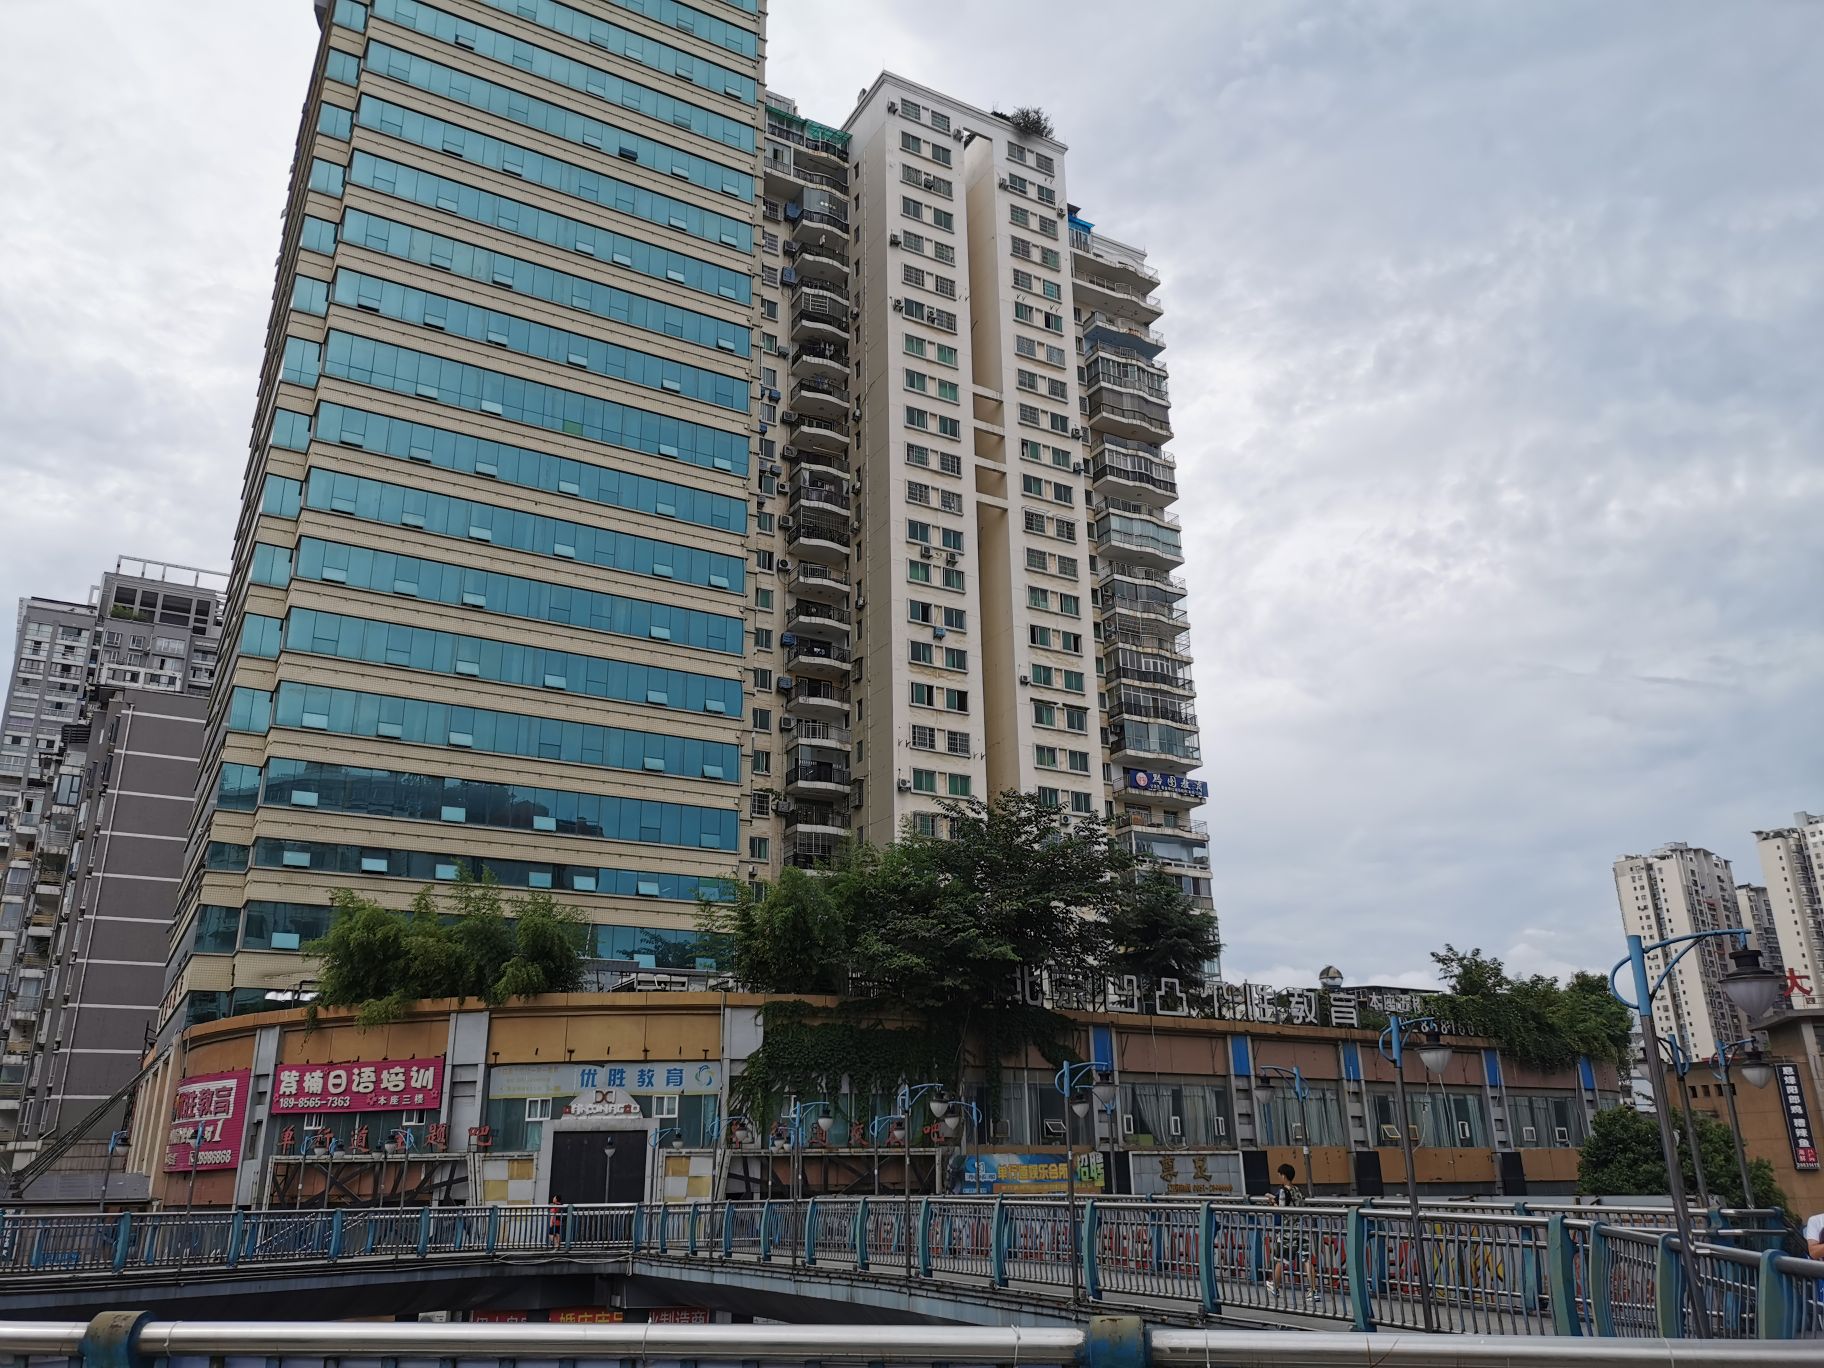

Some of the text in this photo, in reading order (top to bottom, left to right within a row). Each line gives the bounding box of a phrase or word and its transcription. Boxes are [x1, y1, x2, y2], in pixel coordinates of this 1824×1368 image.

[1783, 967, 1813, 997] 大
[579, 1067, 685, 1088] 优胜教育
[279, 1096, 350, 1108] 189-8565-7363
[378, 1093, 425, 1105] 本座三楼
